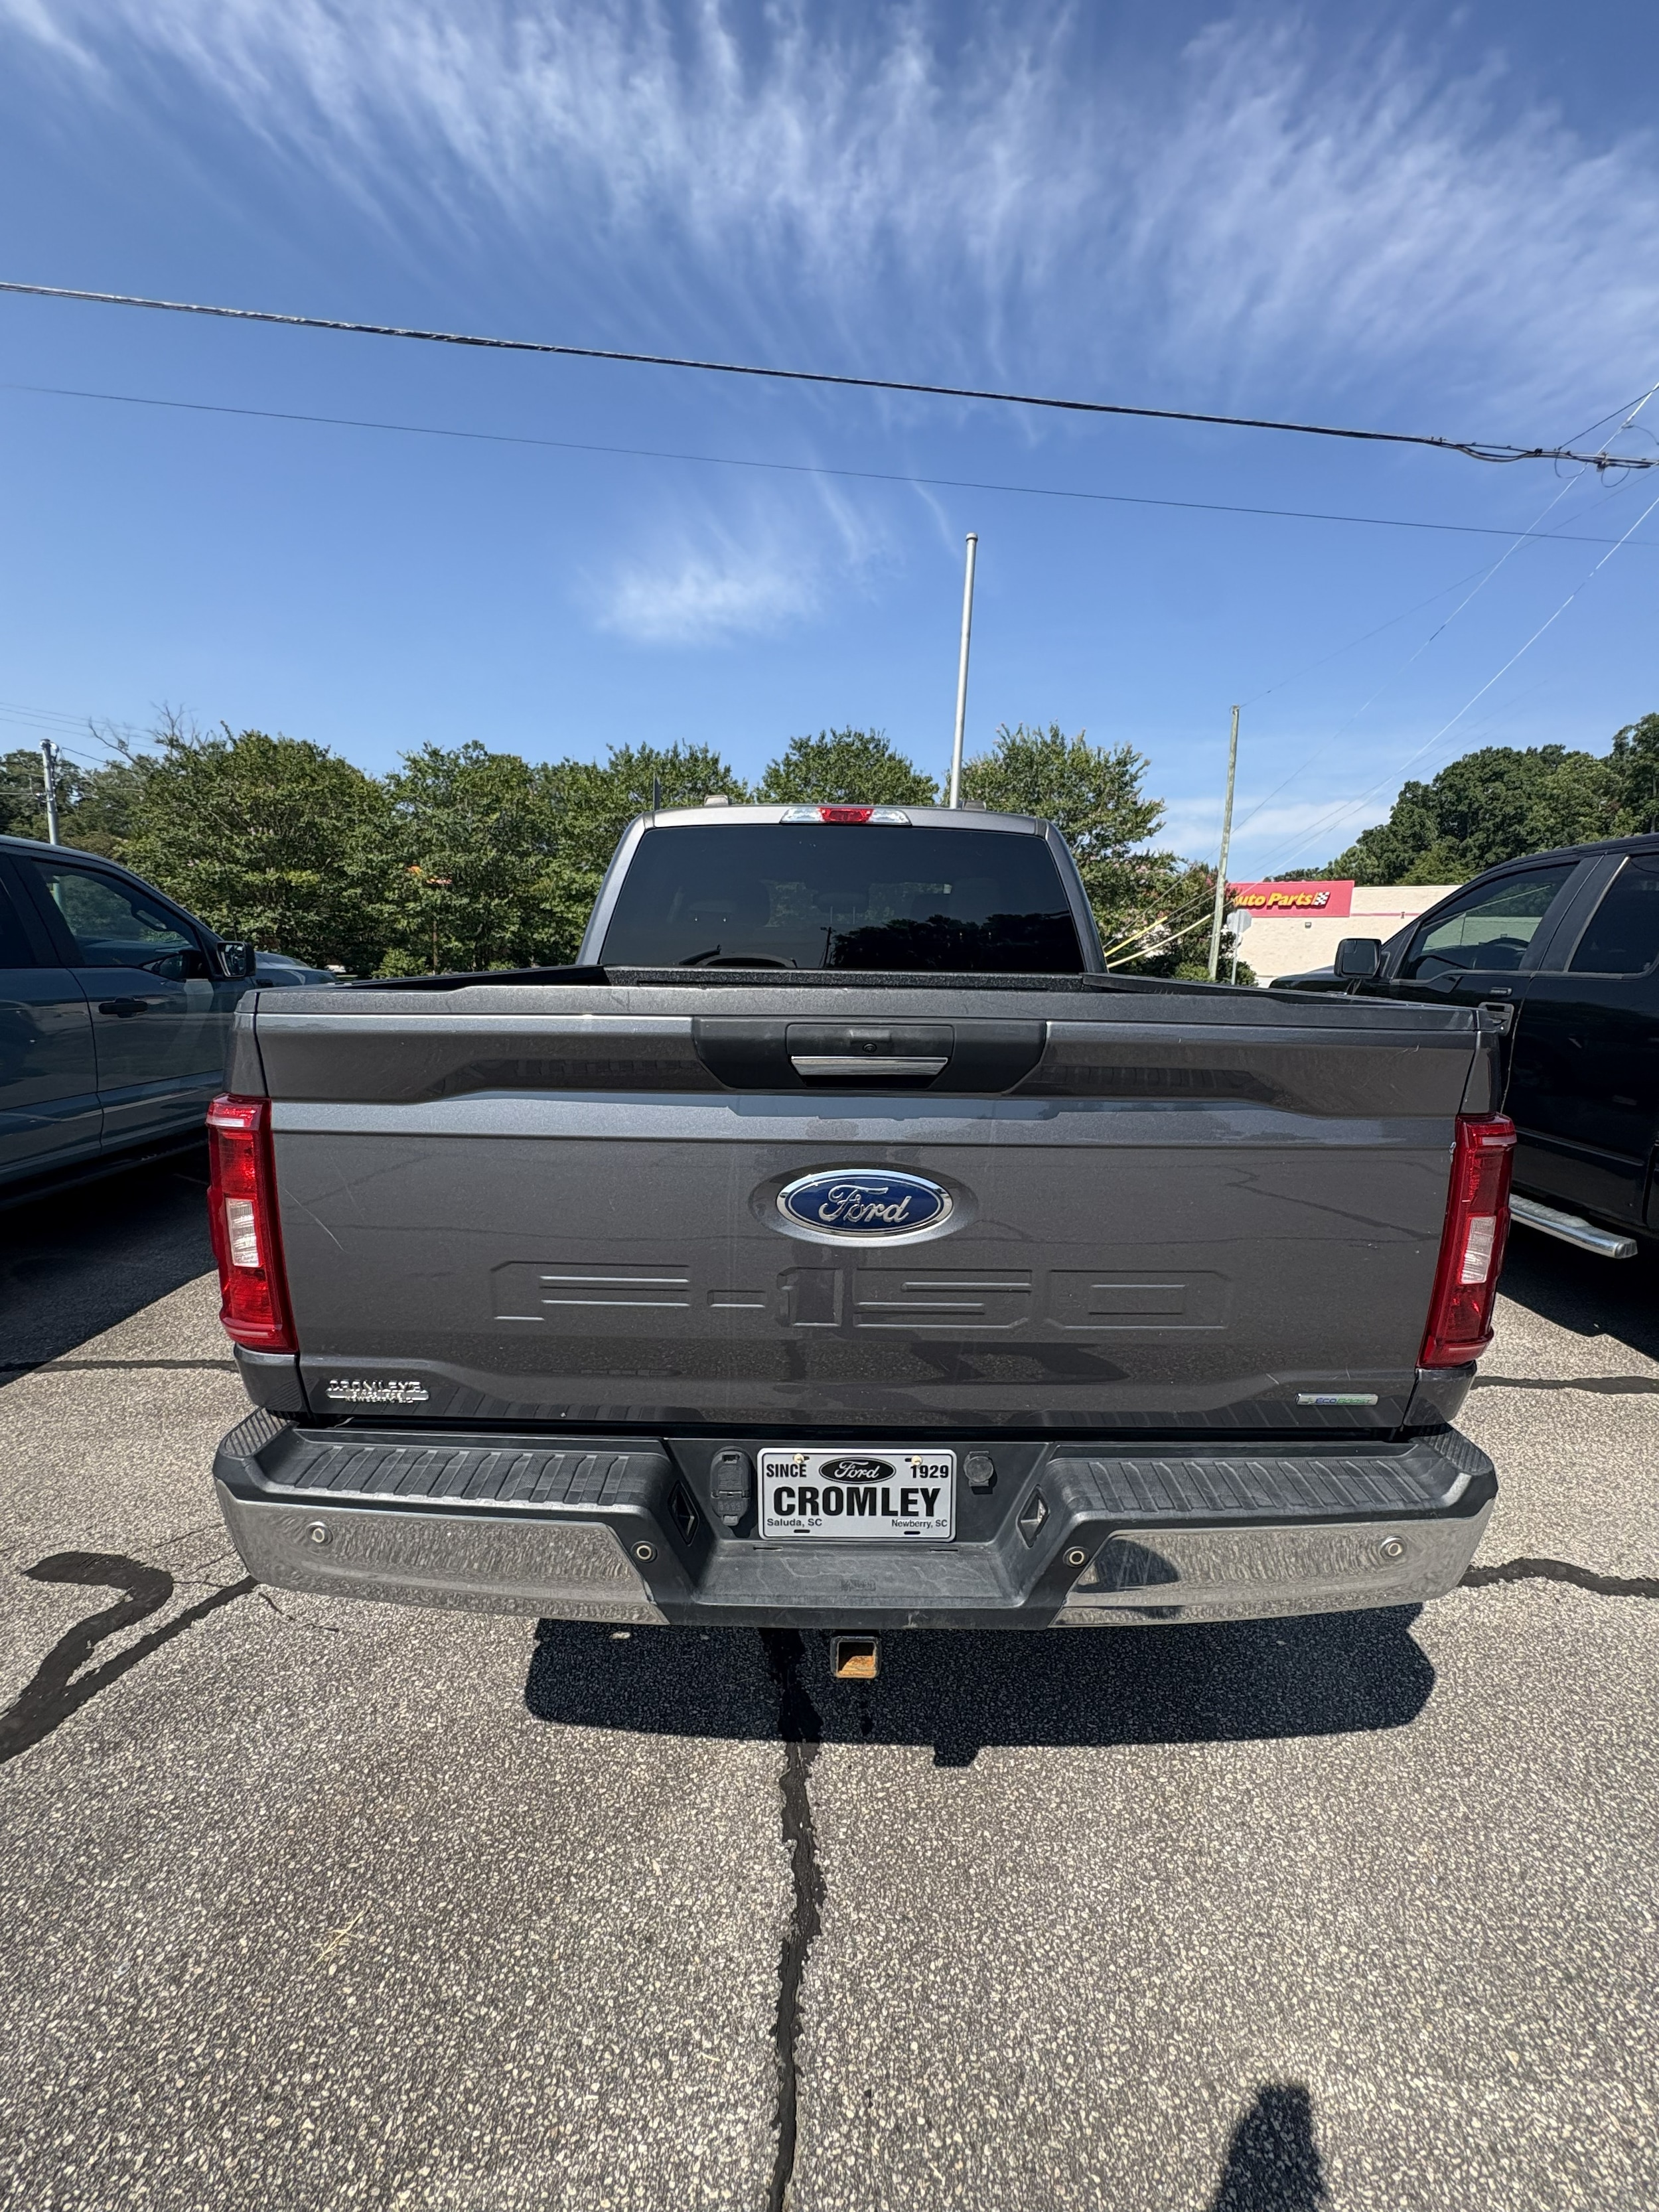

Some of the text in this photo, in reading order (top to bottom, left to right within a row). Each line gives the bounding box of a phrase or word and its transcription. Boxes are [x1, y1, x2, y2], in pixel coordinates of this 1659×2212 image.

[1267, 892, 1312, 906] Parts
[818, 1184, 912, 1222] Ford
[766, 1463, 807, 1477] SINCE
[834, 1460, 880, 1479] Ford
[910, 1465, 949, 1479] 1929
[773, 1486, 941, 1517] CROMLEY
[766, 1518, 805, 1528] Saluda,
[891, 1519, 933, 1528] Newberry,
